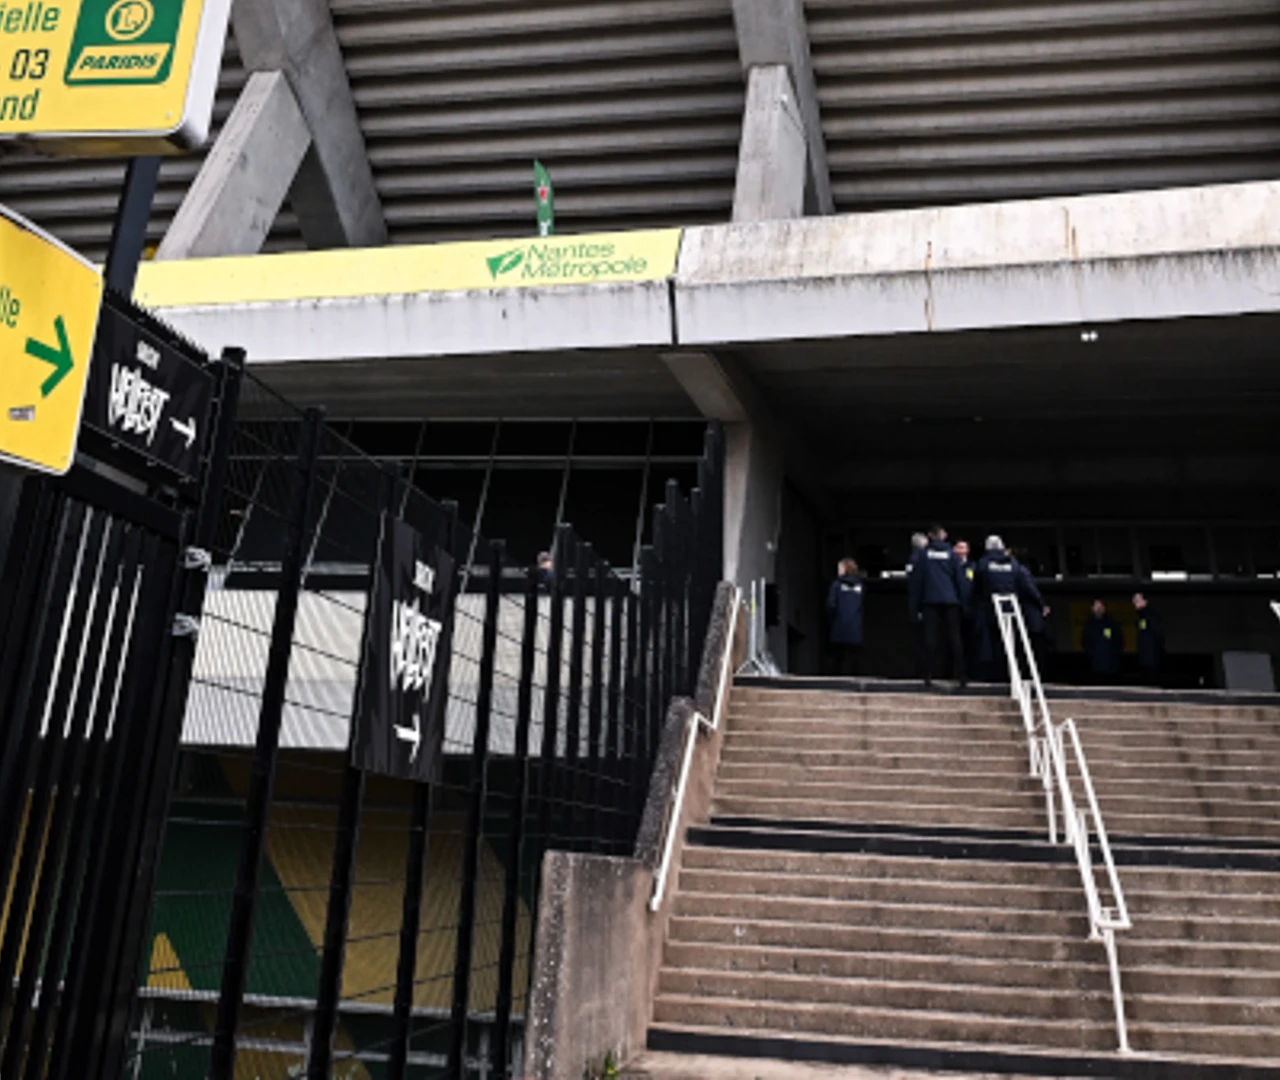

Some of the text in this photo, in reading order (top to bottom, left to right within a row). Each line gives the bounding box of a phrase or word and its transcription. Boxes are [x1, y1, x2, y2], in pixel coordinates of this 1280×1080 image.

[9, 48, 50, 80] 03
[527, 241, 615, 260] Nantes
[521, 255, 647, 280] Métropole
